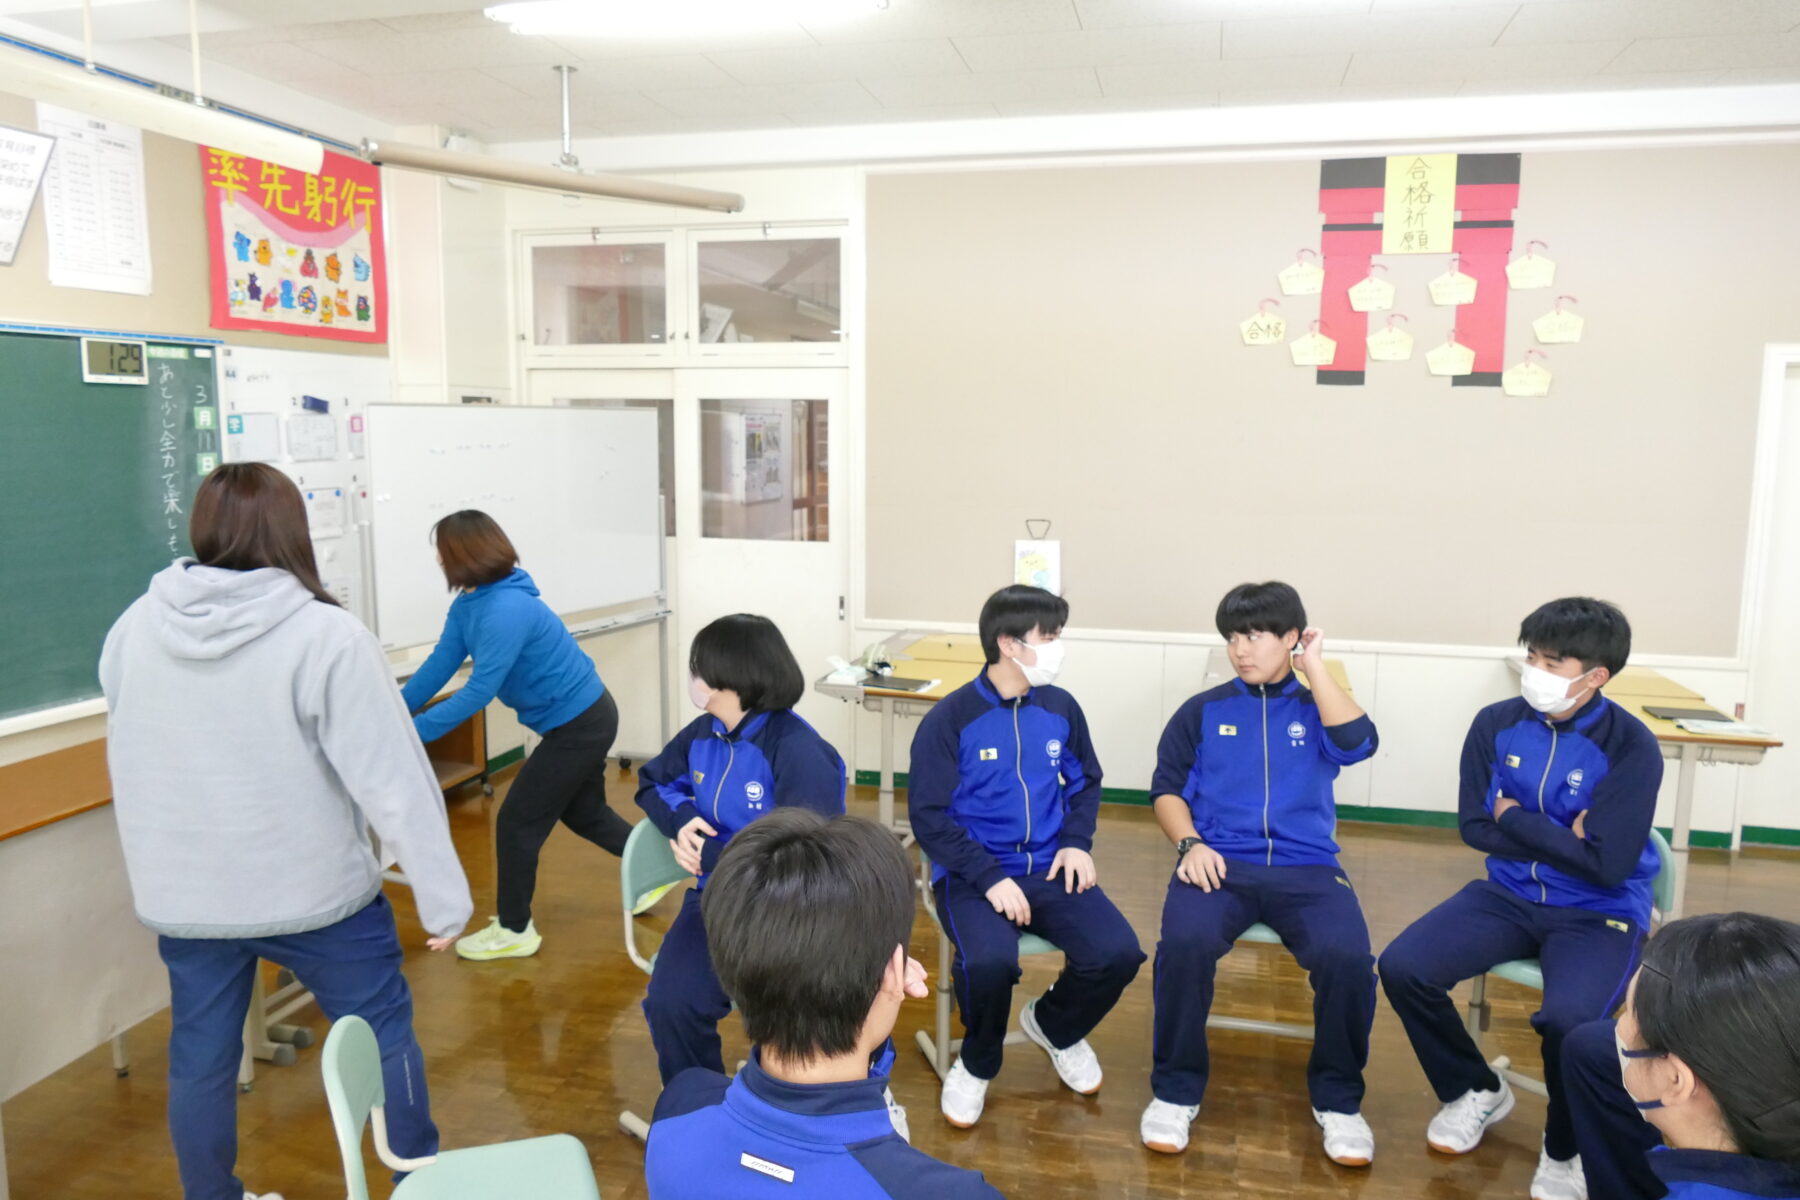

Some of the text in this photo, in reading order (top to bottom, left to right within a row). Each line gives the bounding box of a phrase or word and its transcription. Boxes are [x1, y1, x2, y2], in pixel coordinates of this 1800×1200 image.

[208, 148, 376, 234] 率先躬行
[1400, 155, 1437, 252] 合格祈願
[1246, 320, 1282, 339] 合格
[157, 363, 183, 557] あと少し全力で楽しも
